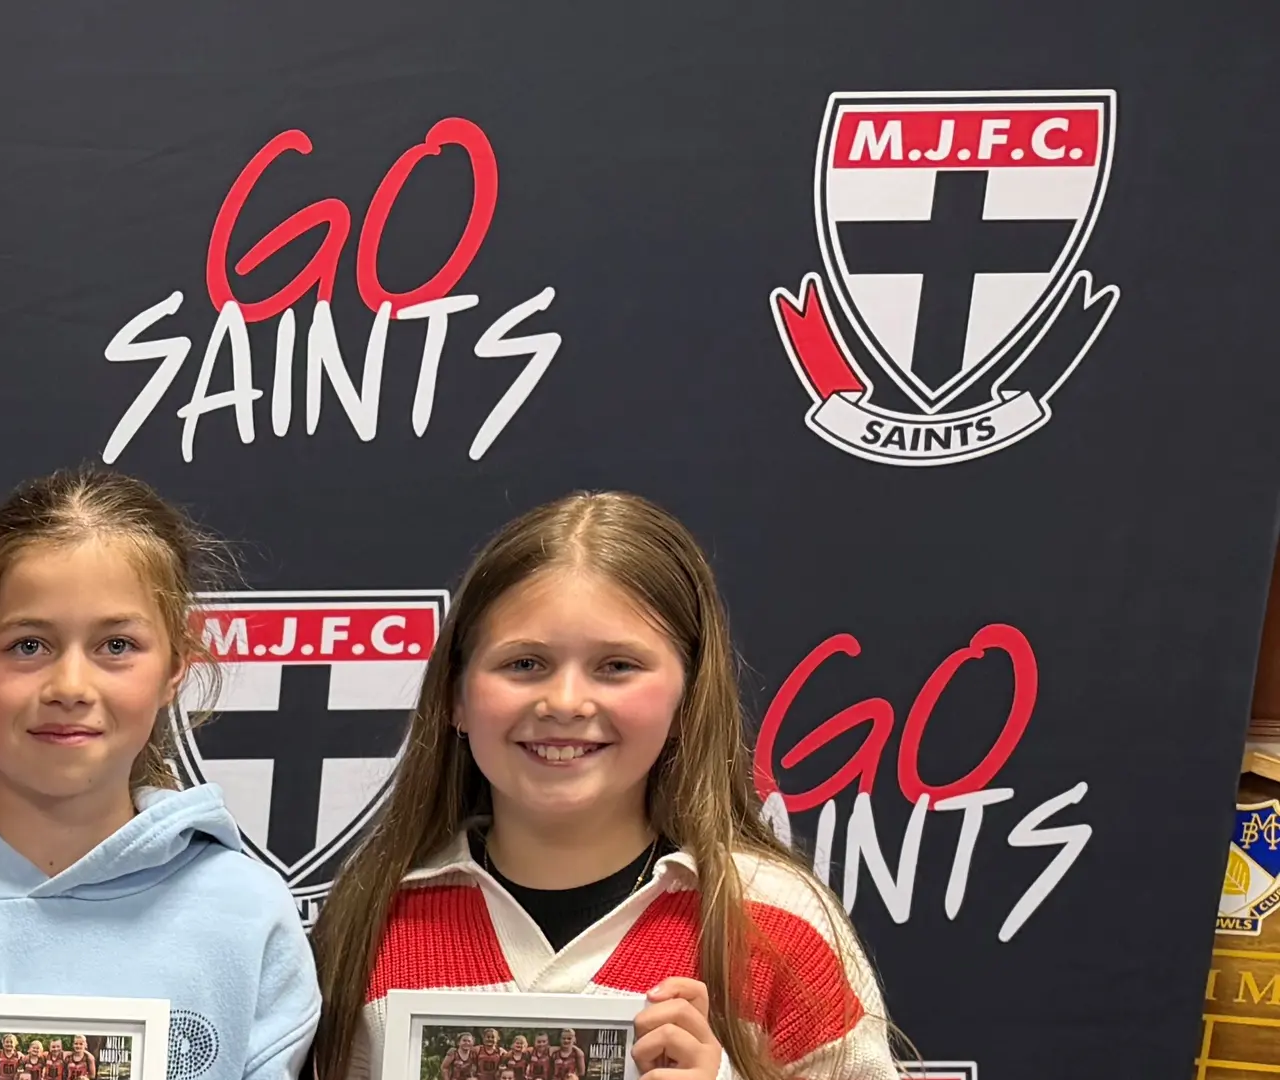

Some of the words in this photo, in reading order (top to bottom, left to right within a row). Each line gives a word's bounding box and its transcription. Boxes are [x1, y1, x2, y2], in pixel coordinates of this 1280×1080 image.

[848, 117, 1083, 161] M.J.F.C.
[205, 117, 498, 322] GO
[102, 286, 562, 464] SAINTS
[860, 416, 996, 452] SAINTS
[202, 615, 421, 656] M.J.F.C.
[753, 623, 1038, 812] GO
